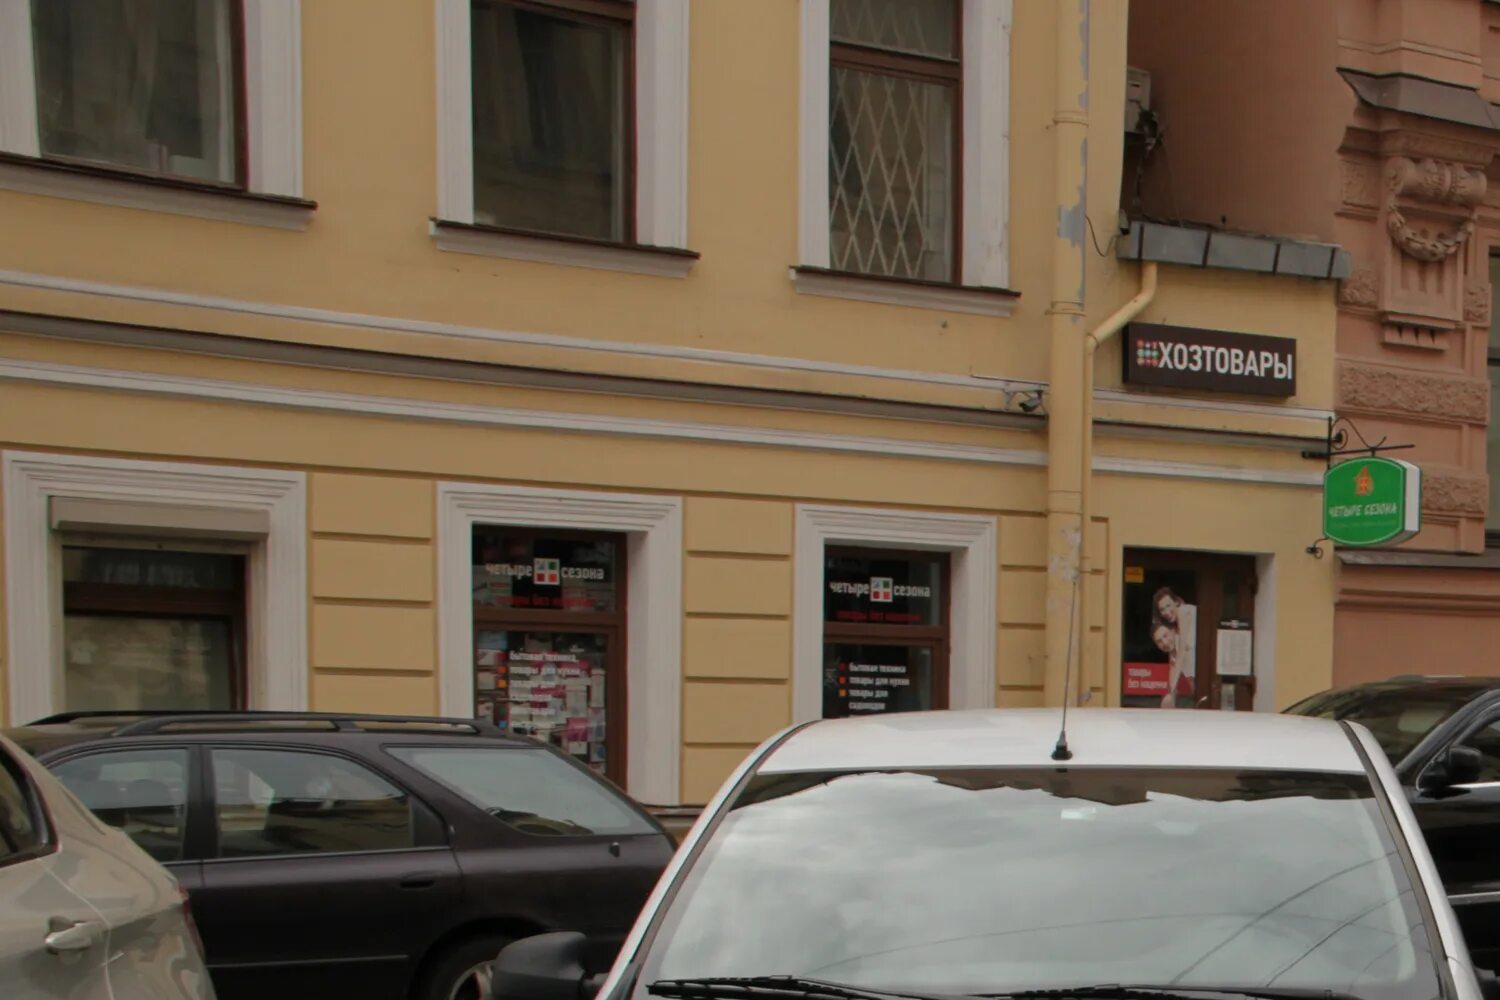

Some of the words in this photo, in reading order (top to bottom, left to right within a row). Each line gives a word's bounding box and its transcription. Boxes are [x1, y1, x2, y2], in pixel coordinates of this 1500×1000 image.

[1158, 341, 1293, 381] ХОЗТОВАРЫ
[1328, 504, 1362, 518] ЧЕТЫРЕ
[1363, 502, 1398, 516] СЕЗОНА
[485, 563, 532, 579] четыре
[560, 566, 605, 580] сезона
[829, 581, 869, 597] четыре
[893, 584, 931, 598] сезона
